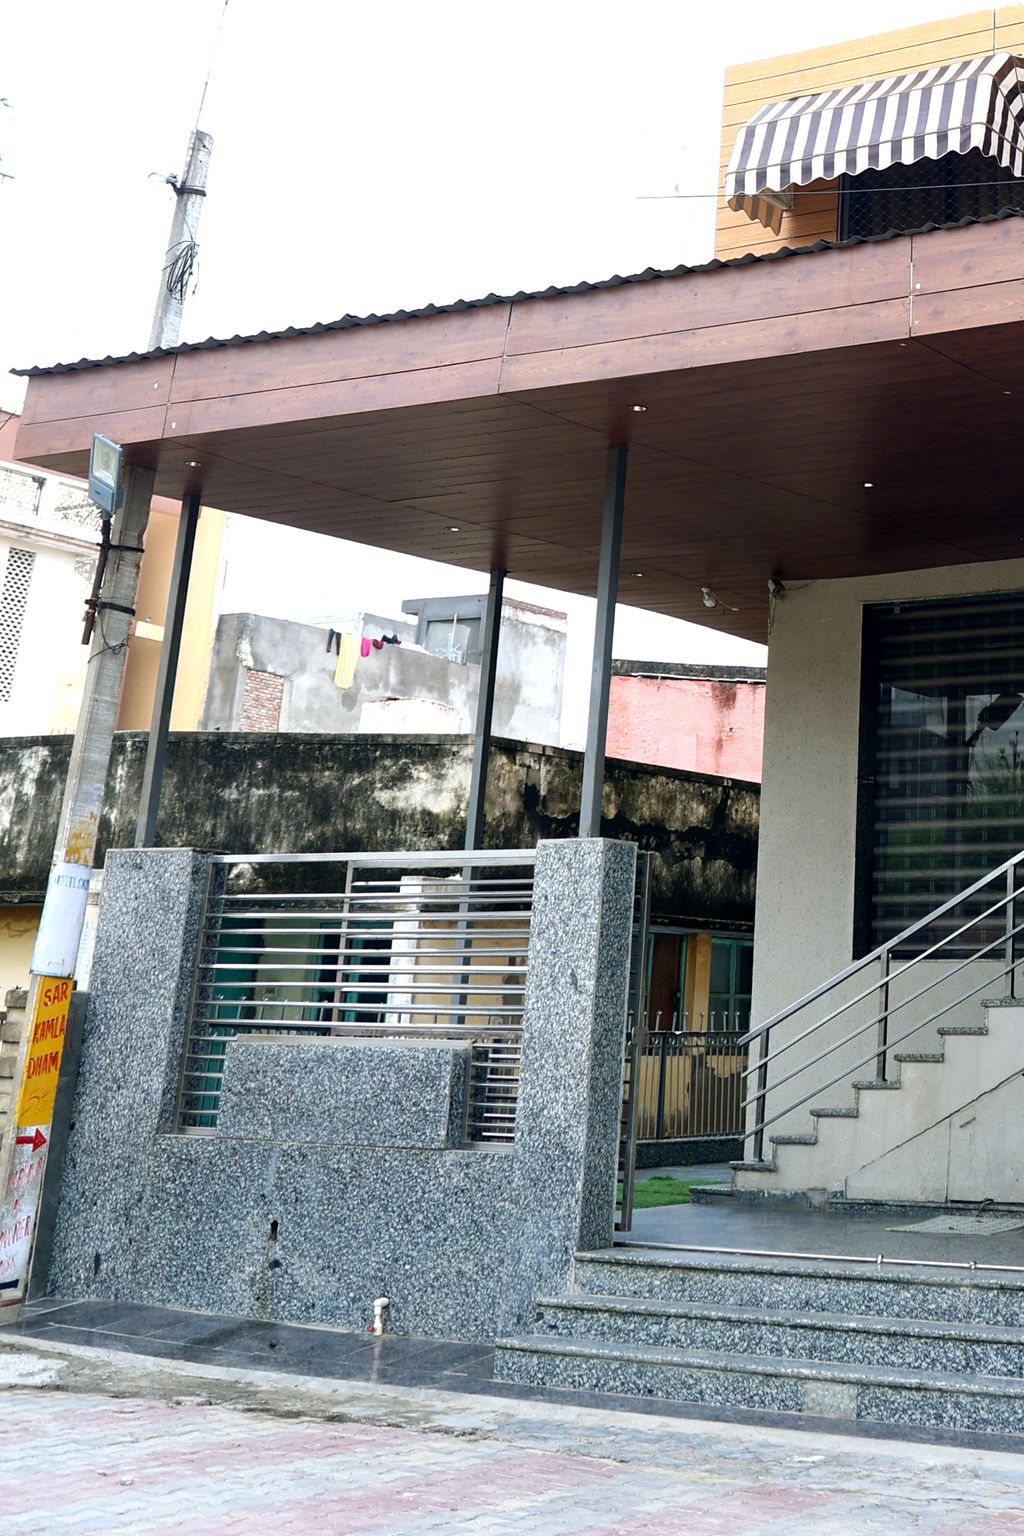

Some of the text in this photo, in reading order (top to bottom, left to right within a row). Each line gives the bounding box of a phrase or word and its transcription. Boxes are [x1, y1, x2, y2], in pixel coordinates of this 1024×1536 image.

[43, 982, 69, 1007] SAR
[32, 1014, 66, 1045] KAMLA
[27, 1051, 59, 1079] DHAM
